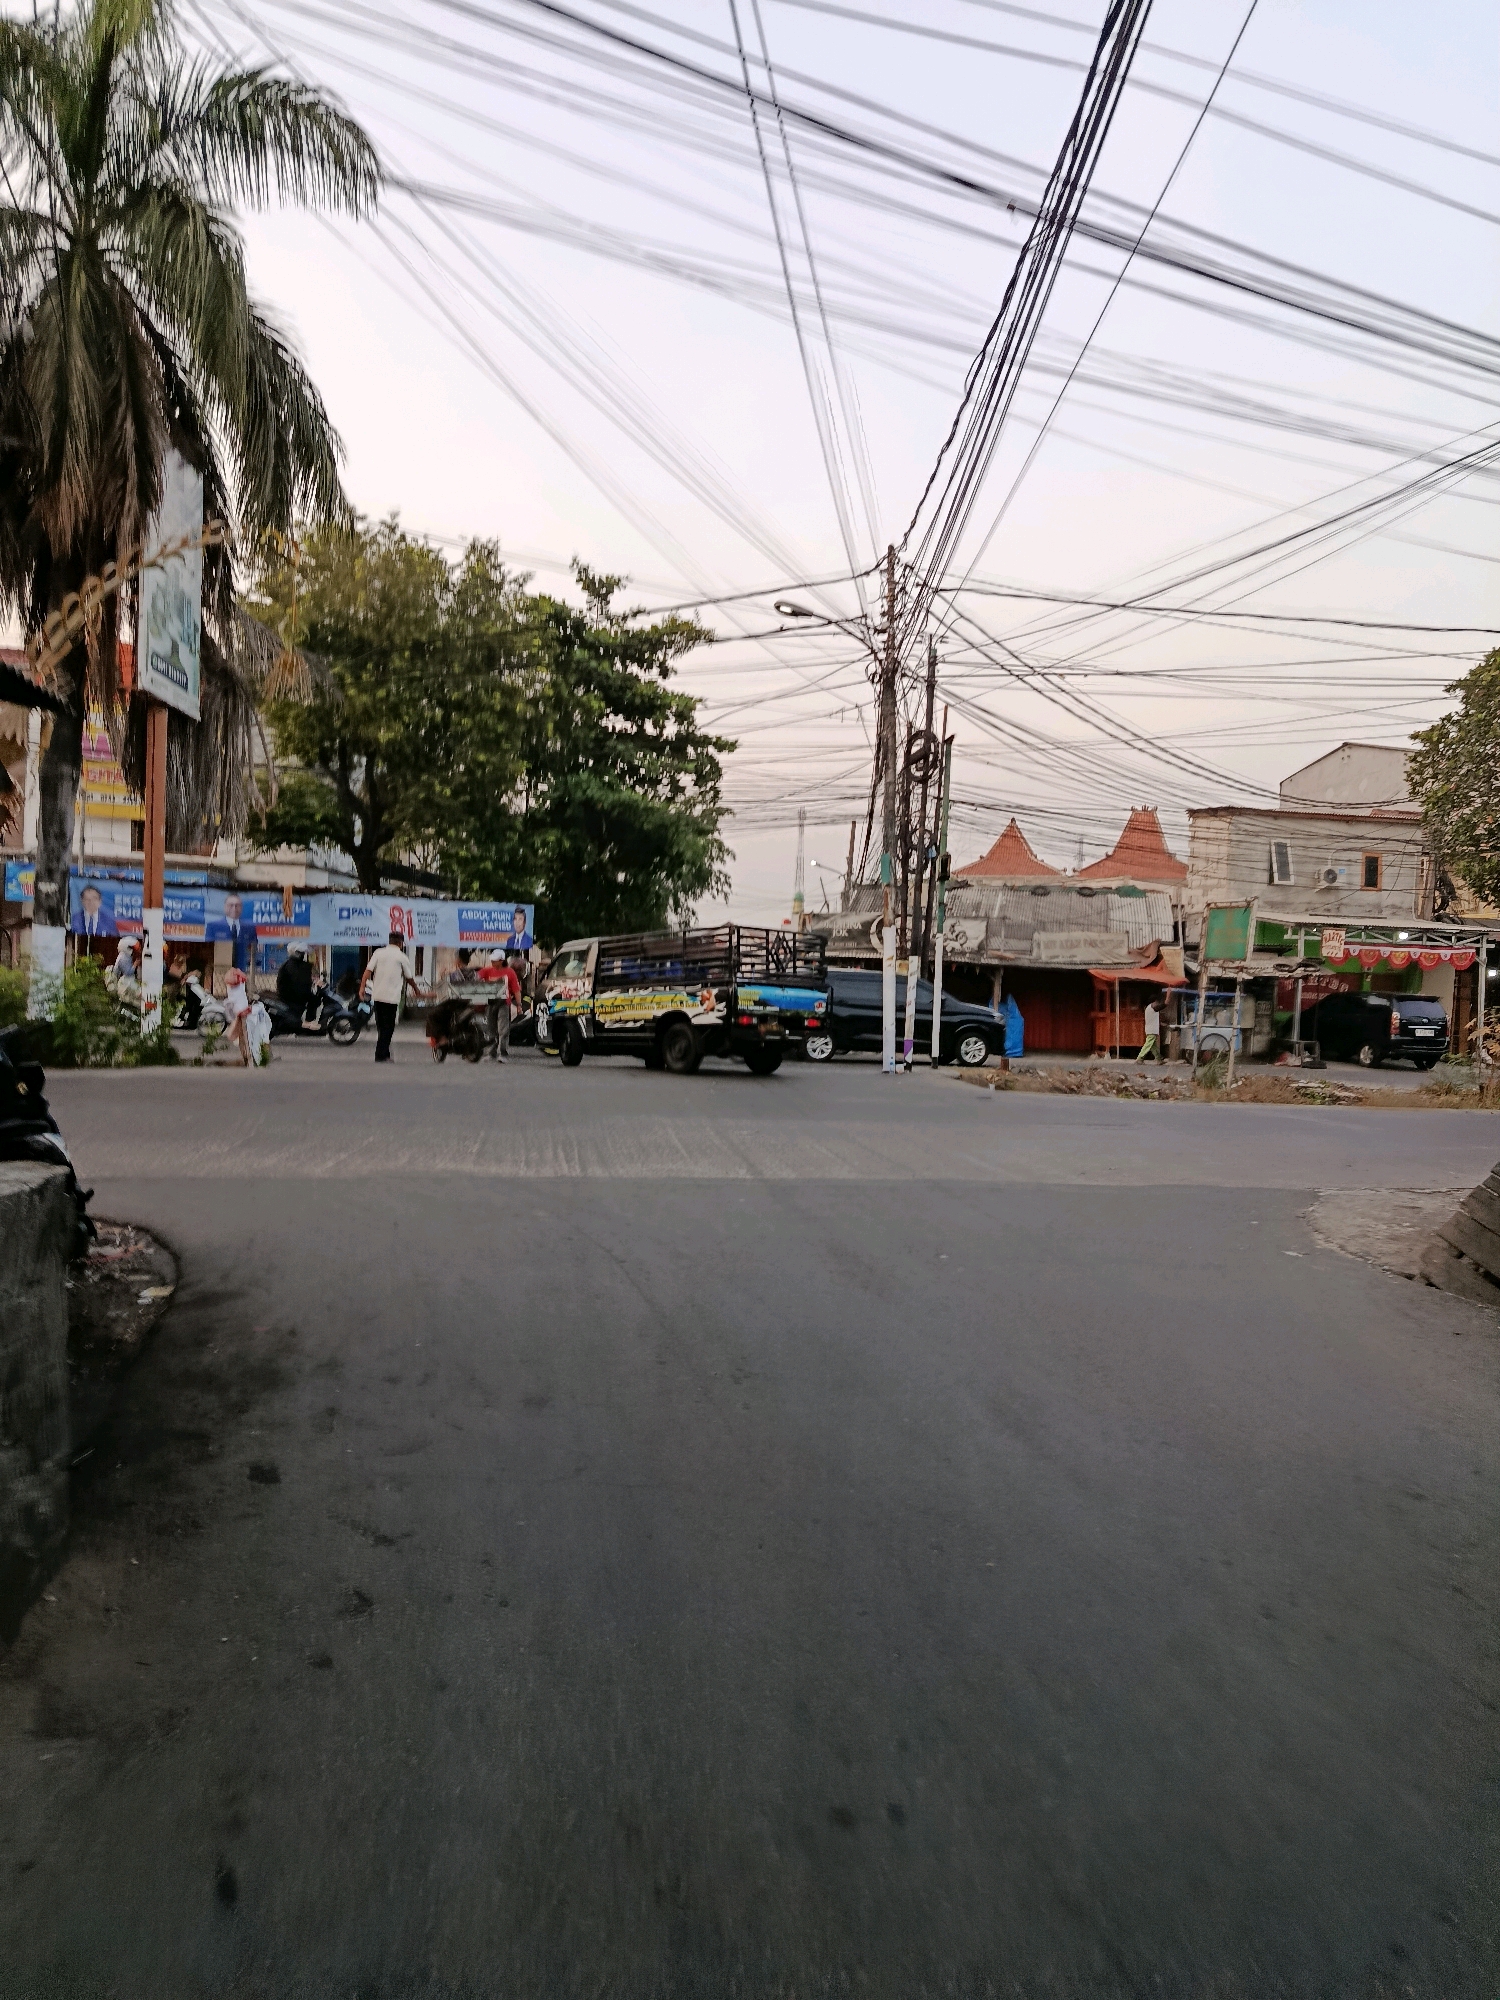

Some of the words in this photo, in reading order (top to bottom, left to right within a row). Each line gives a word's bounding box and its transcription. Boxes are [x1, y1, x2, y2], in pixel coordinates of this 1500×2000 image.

[114, 894, 141, 908] EKO
[351, 907, 372, 917] PAN
[461, 910, 489, 921] ABDUL
